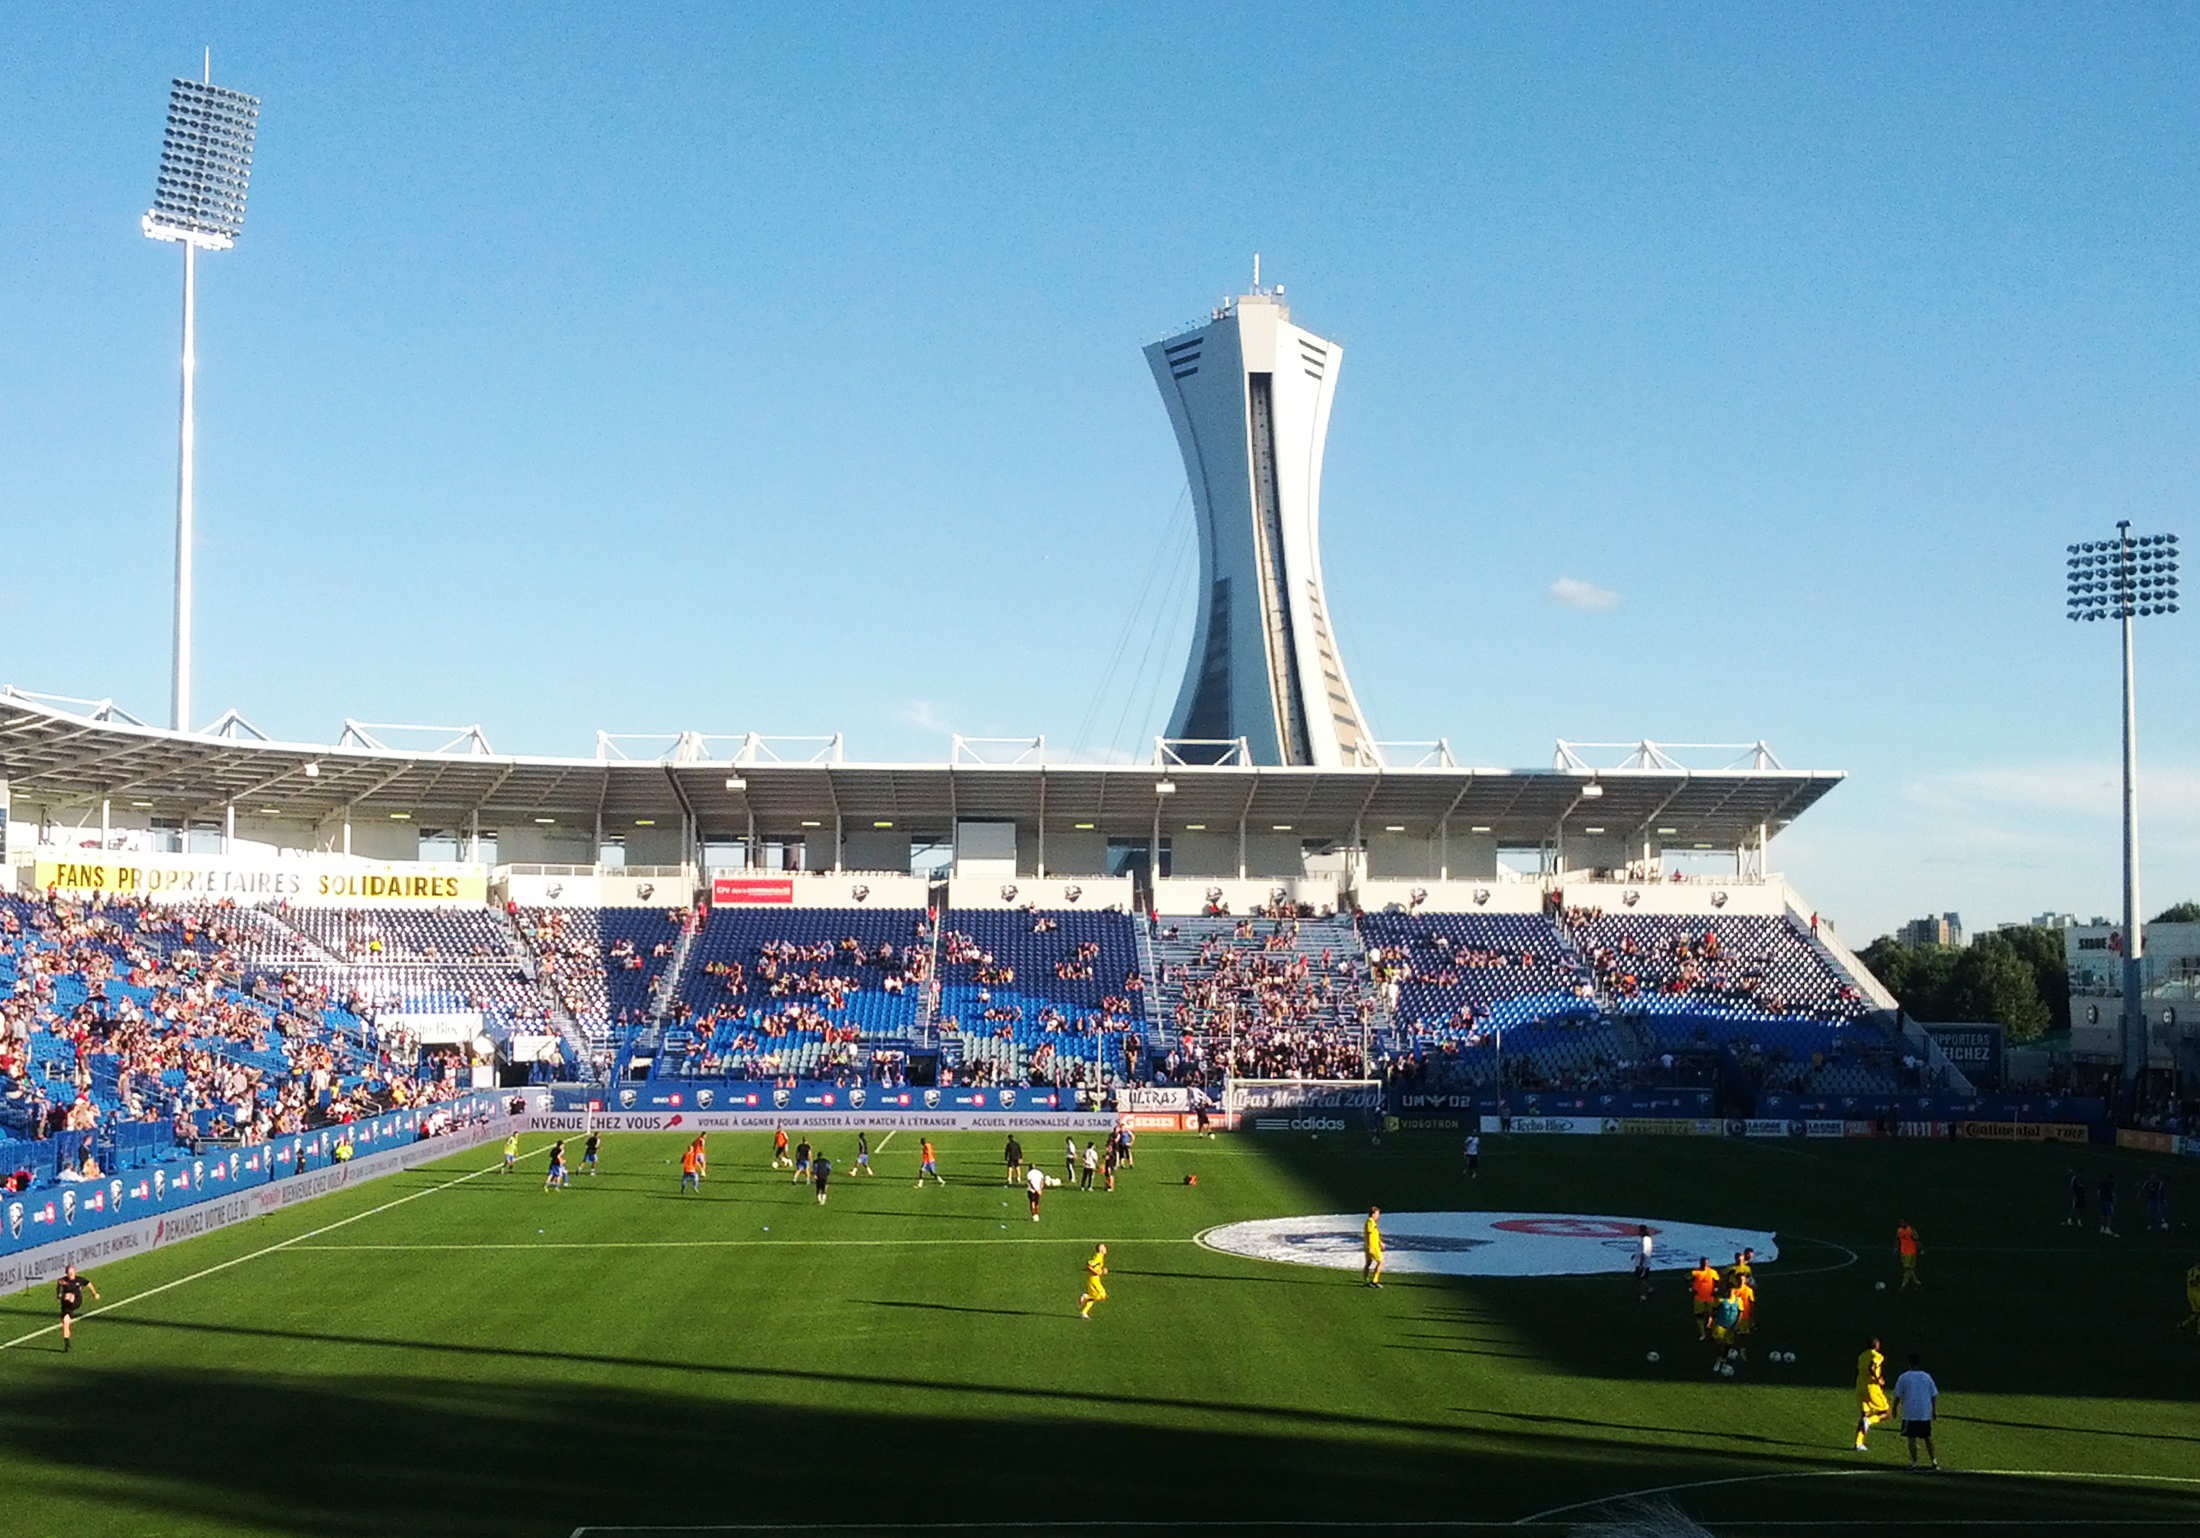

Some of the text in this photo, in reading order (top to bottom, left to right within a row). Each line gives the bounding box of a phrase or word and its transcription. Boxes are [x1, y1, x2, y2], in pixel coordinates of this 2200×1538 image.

[57, 863, 459, 898] FANS PROPRIETAIRES SOLIDAIRES
[1129, 1091, 1177, 1105] ULTRAS
[590, 1117, 621, 1130] CHEZ
[626, 1117, 661, 1130] VOUS
[698, 1118, 729, 1127] VOYAGE
[732, 1115, 739, 1126] À
[741, 1118, 774, 1127] GAGNER
[778, 1118, 800, 1127] POUR
[802, 1118, 841, 1127] ASSISTER
[844, 1116, 851, 1126] À
[853, 1118, 866, 1126] UN
[868, 1118, 896, 1126] MATCH
[899, 1116, 905, 1126] À
[971, 1118, 1006, 1127] ACCUEIL
[1009, 1116, 1070, 1127] PERSONNALISÉ
[1073, 1118, 1085, 1127] AU
[1087, 1118, 1112, 1127] STADE
[1135, 1117, 1175, 1128] SERIES
[1290, 1116, 1346, 1131] adidas
[1966, 1122, 2040, 1137] Continental
[2056, 1127, 2086, 1138] TIRE
